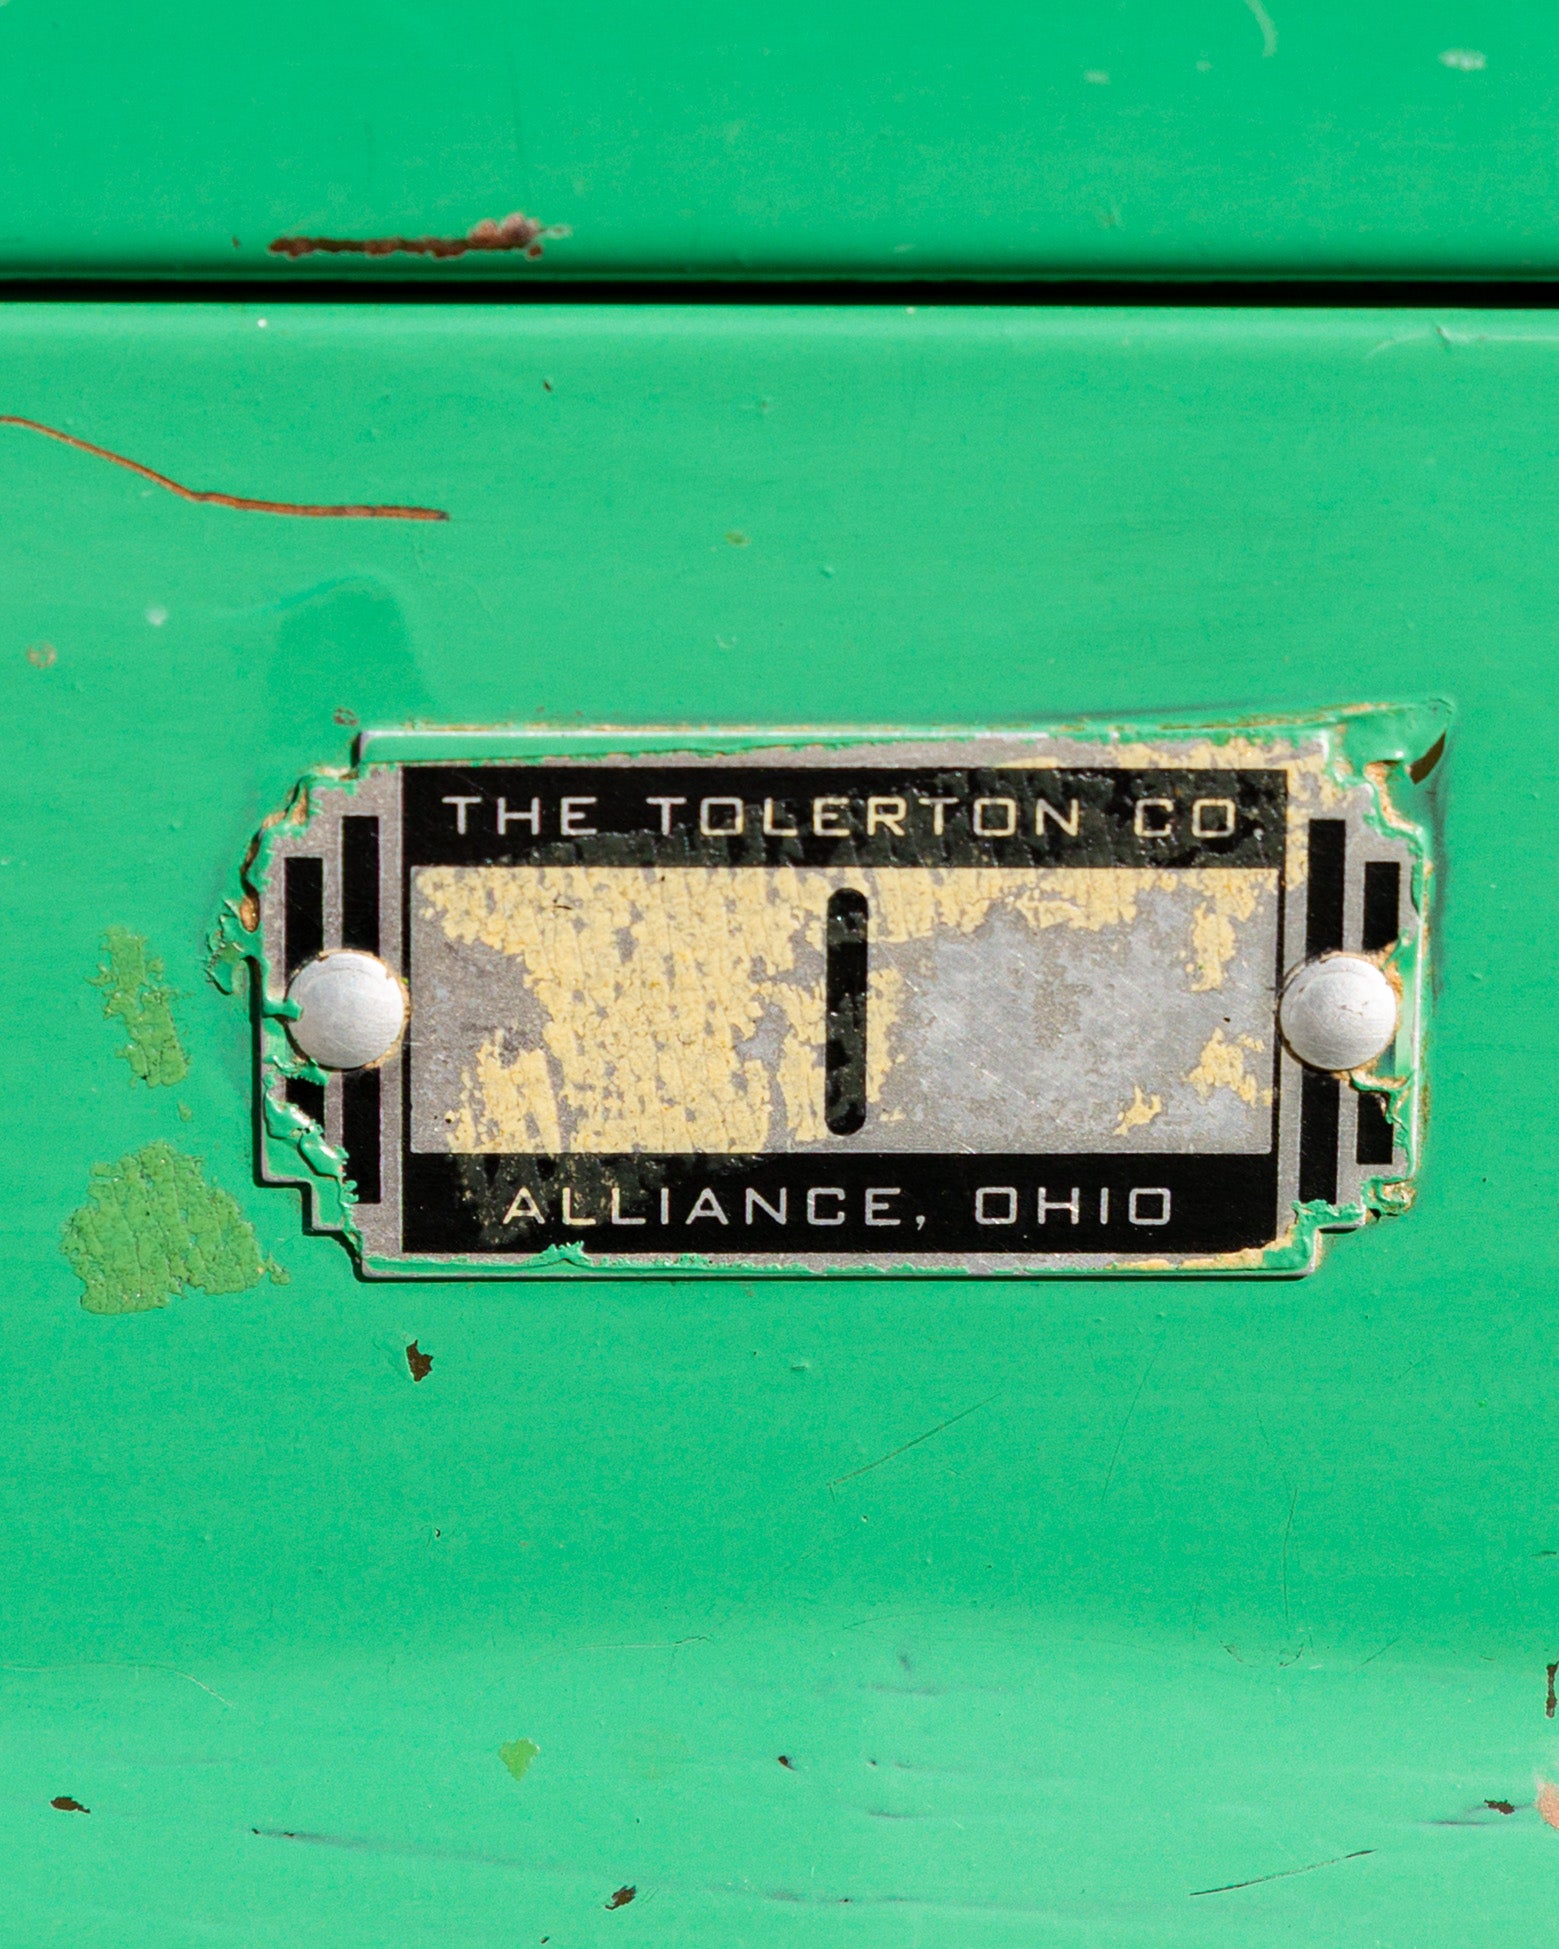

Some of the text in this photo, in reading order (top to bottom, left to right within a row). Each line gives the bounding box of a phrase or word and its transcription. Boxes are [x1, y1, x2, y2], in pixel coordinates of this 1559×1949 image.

[442, 796, 597, 836] THE
[646, 796, 1078, 837] TOLERTON
[502, 1186, 1171, 1230] ALLIANCE, OHIO
